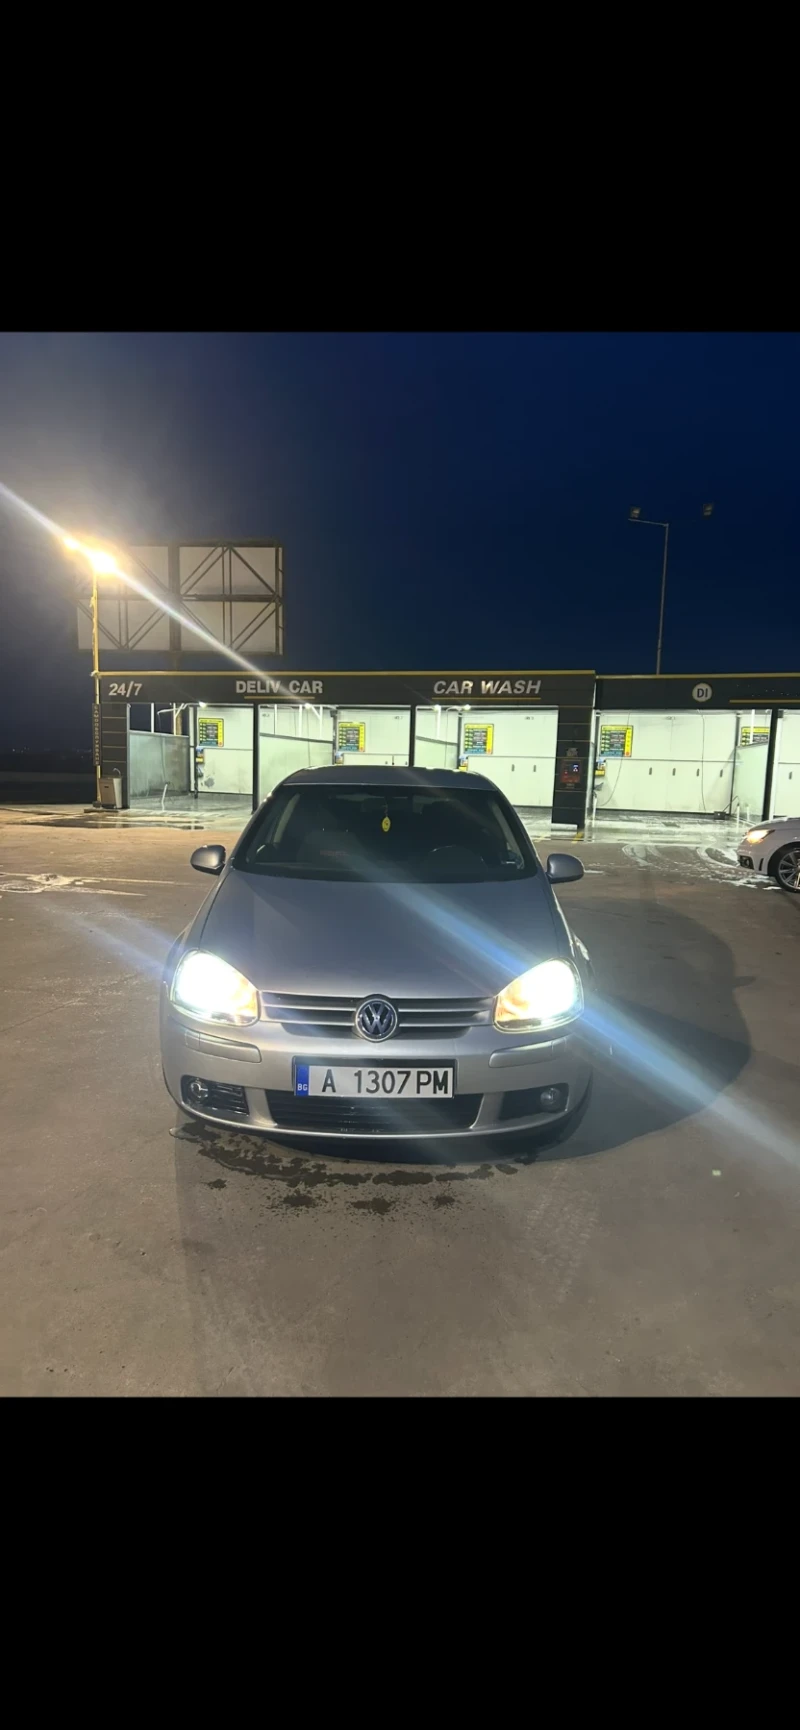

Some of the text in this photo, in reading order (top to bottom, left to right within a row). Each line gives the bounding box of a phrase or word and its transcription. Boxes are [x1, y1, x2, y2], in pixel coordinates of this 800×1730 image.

[108, 682, 142, 698] 24/7
[235, 680, 323, 694] DELIV CAR
[433, 680, 541, 694] CAR WASH
[297, 1083, 308, 1091] BG
[321, 1068, 449, 1094] A 1307 PM
